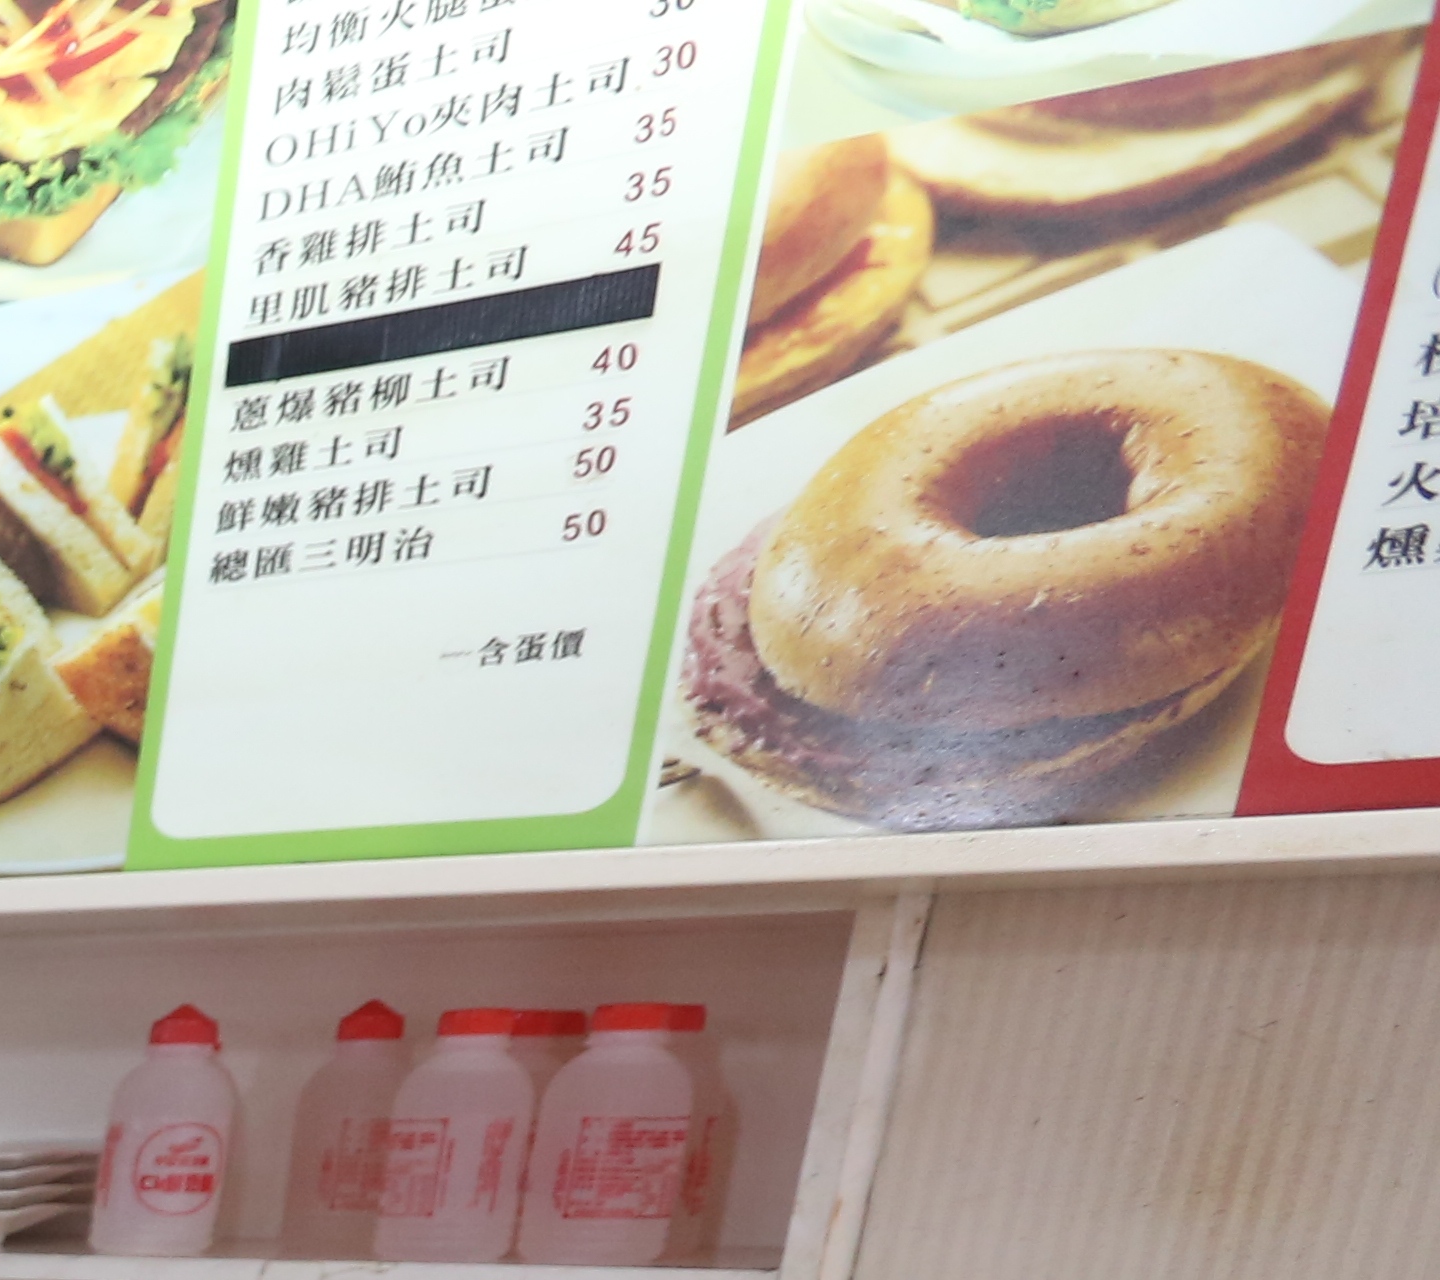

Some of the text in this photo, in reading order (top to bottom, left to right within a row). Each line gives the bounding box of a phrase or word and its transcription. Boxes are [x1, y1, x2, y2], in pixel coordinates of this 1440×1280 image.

[275, 28, 513, 116] 肉鬆蛋土司
[653, 41, 697, 77] 30
[259, 107, 678, 222] DHA鮪魚土司 35
[255, 166, 673, 277] 香雞排土司 35
[246, 222, 662, 329] 里肌豬排土司 45
[592, 342, 638, 374] 40
[223, 398, 631, 484] 燻雞土司 35
[216, 446, 617, 534] 鮮嫩豬排土司 50
[209, 510, 607, 584] 總匯三明治 50
